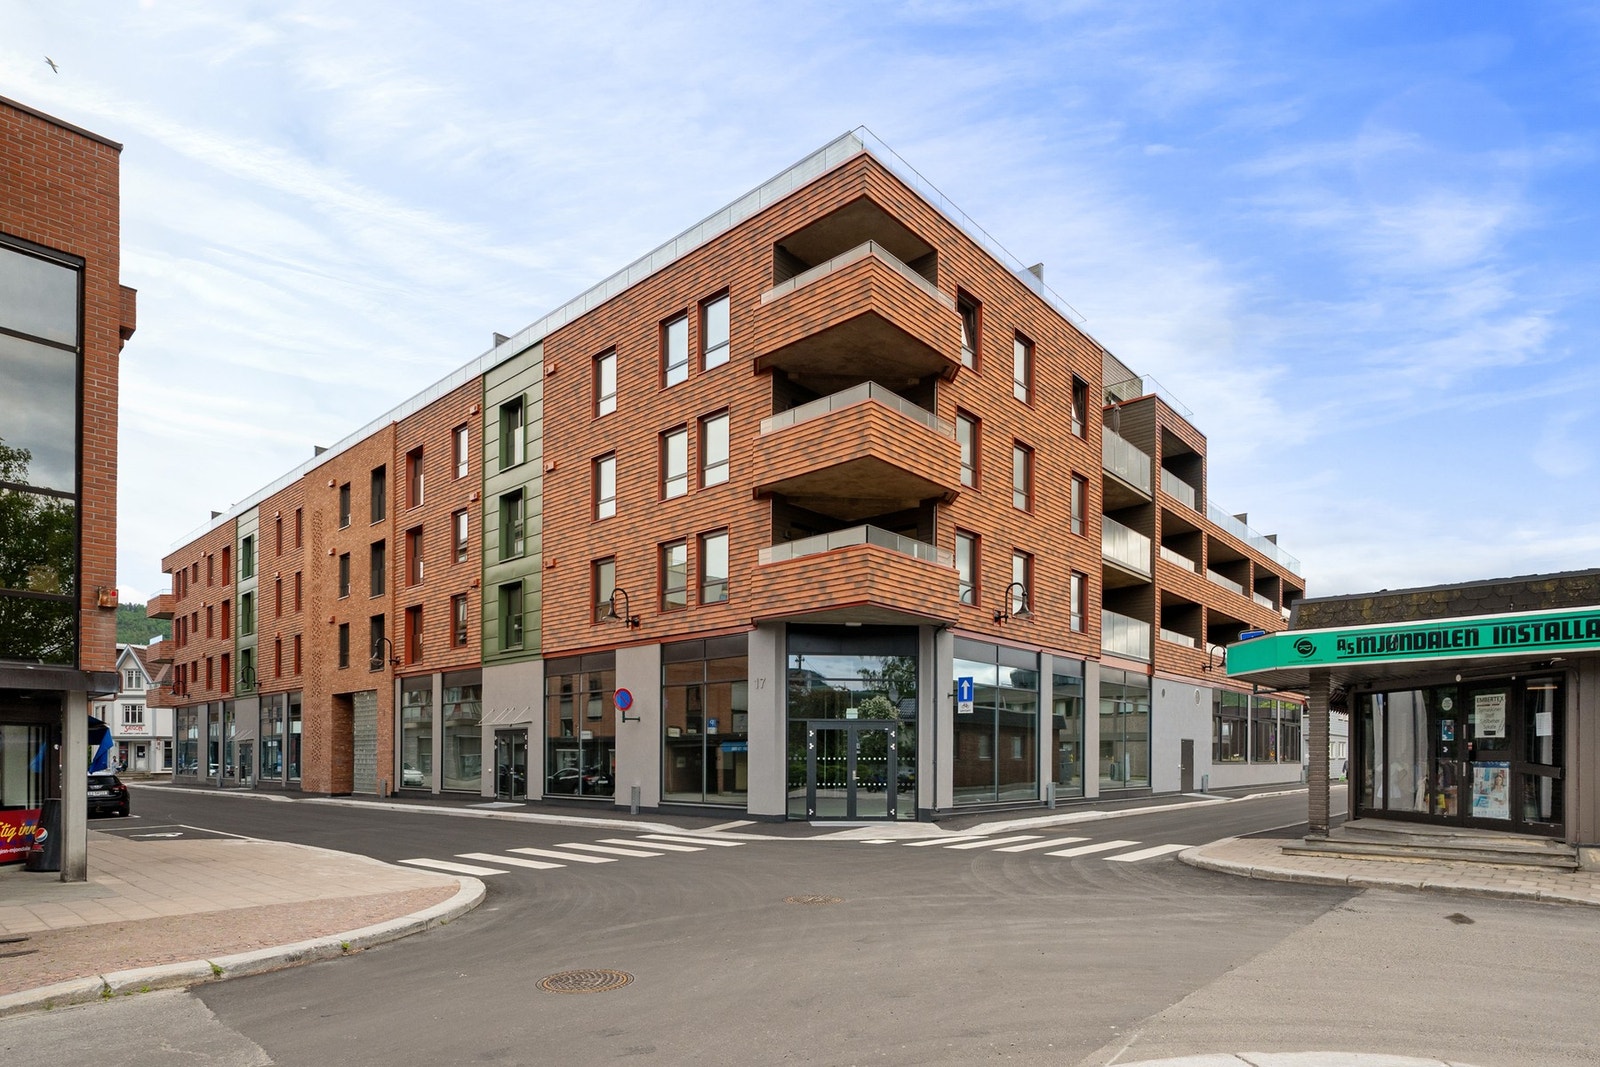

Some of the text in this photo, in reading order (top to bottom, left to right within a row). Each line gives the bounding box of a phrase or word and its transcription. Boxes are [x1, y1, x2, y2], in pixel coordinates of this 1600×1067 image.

[1356, 628, 1479, 654] MJØNDALEN
[1493, 618, 1600, 645] INSTALLA
[754, 677, 766, 689] 17
[0, 822, 37, 843] tig inn
